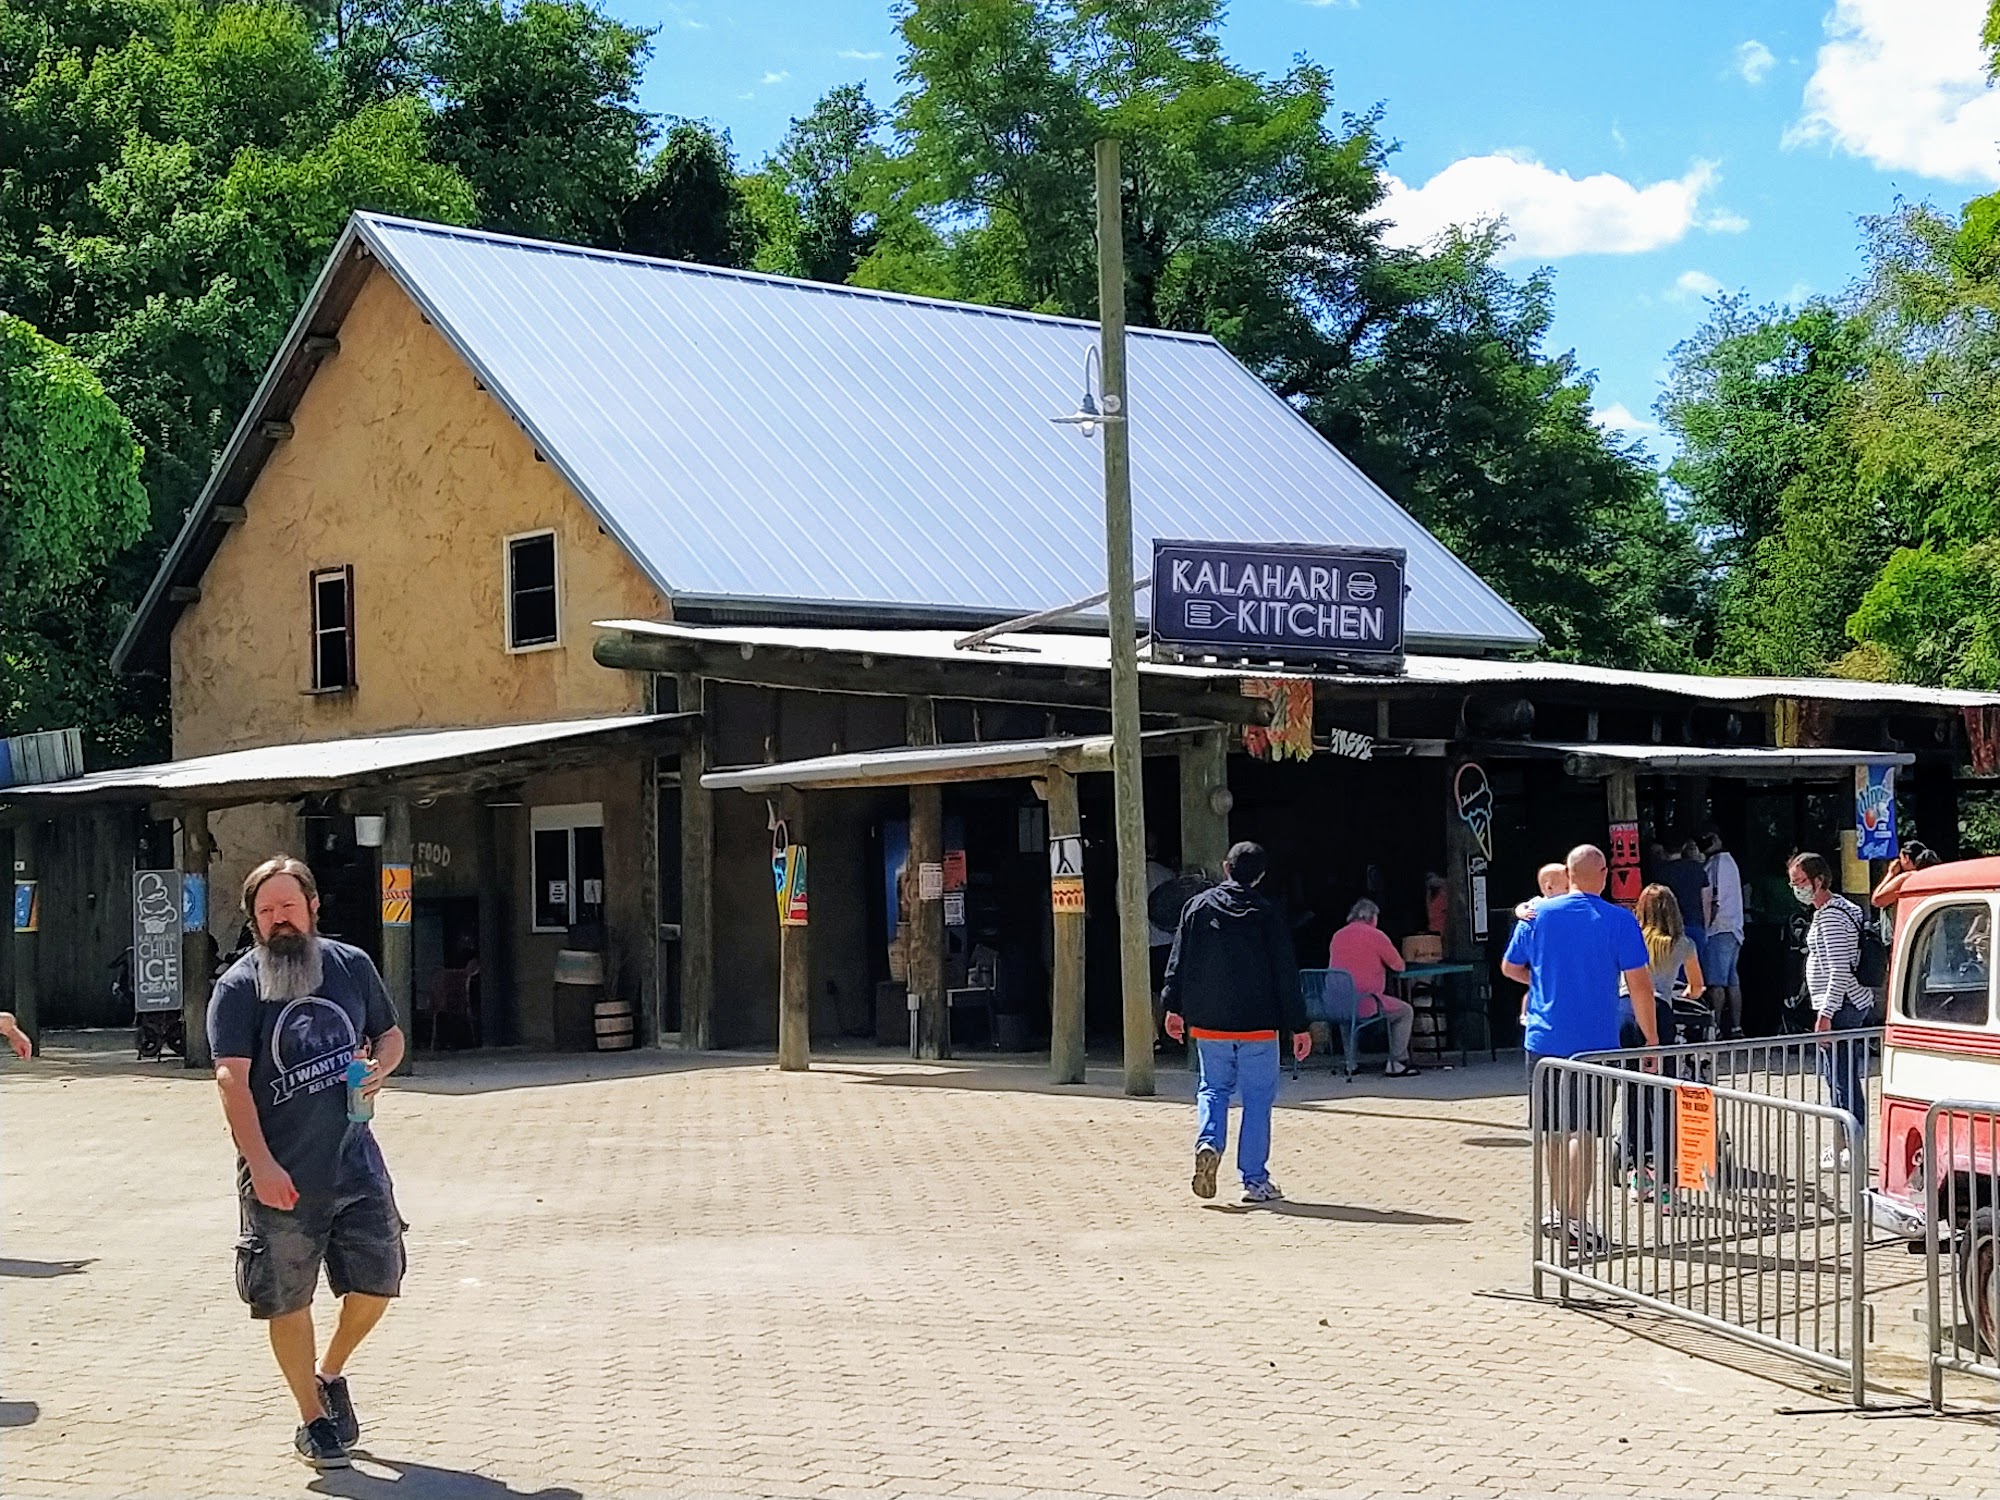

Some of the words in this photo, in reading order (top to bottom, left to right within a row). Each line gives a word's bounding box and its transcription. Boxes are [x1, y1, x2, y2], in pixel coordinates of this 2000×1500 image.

[1172, 558, 1341, 602] KALAHARI
[1237, 598, 1385, 641] KITCHEN
[417, 842, 451, 867] FOOD
[138, 942, 176, 959] CHILL
[138, 958, 177, 982] ICE
[139, 981, 178, 994] CREAM
[288, 1074, 295, 1087] I
[295, 1056, 337, 1083] WANT
[337, 1051, 353, 1066] TO
[308, 1075, 341, 1095] BELIEV
